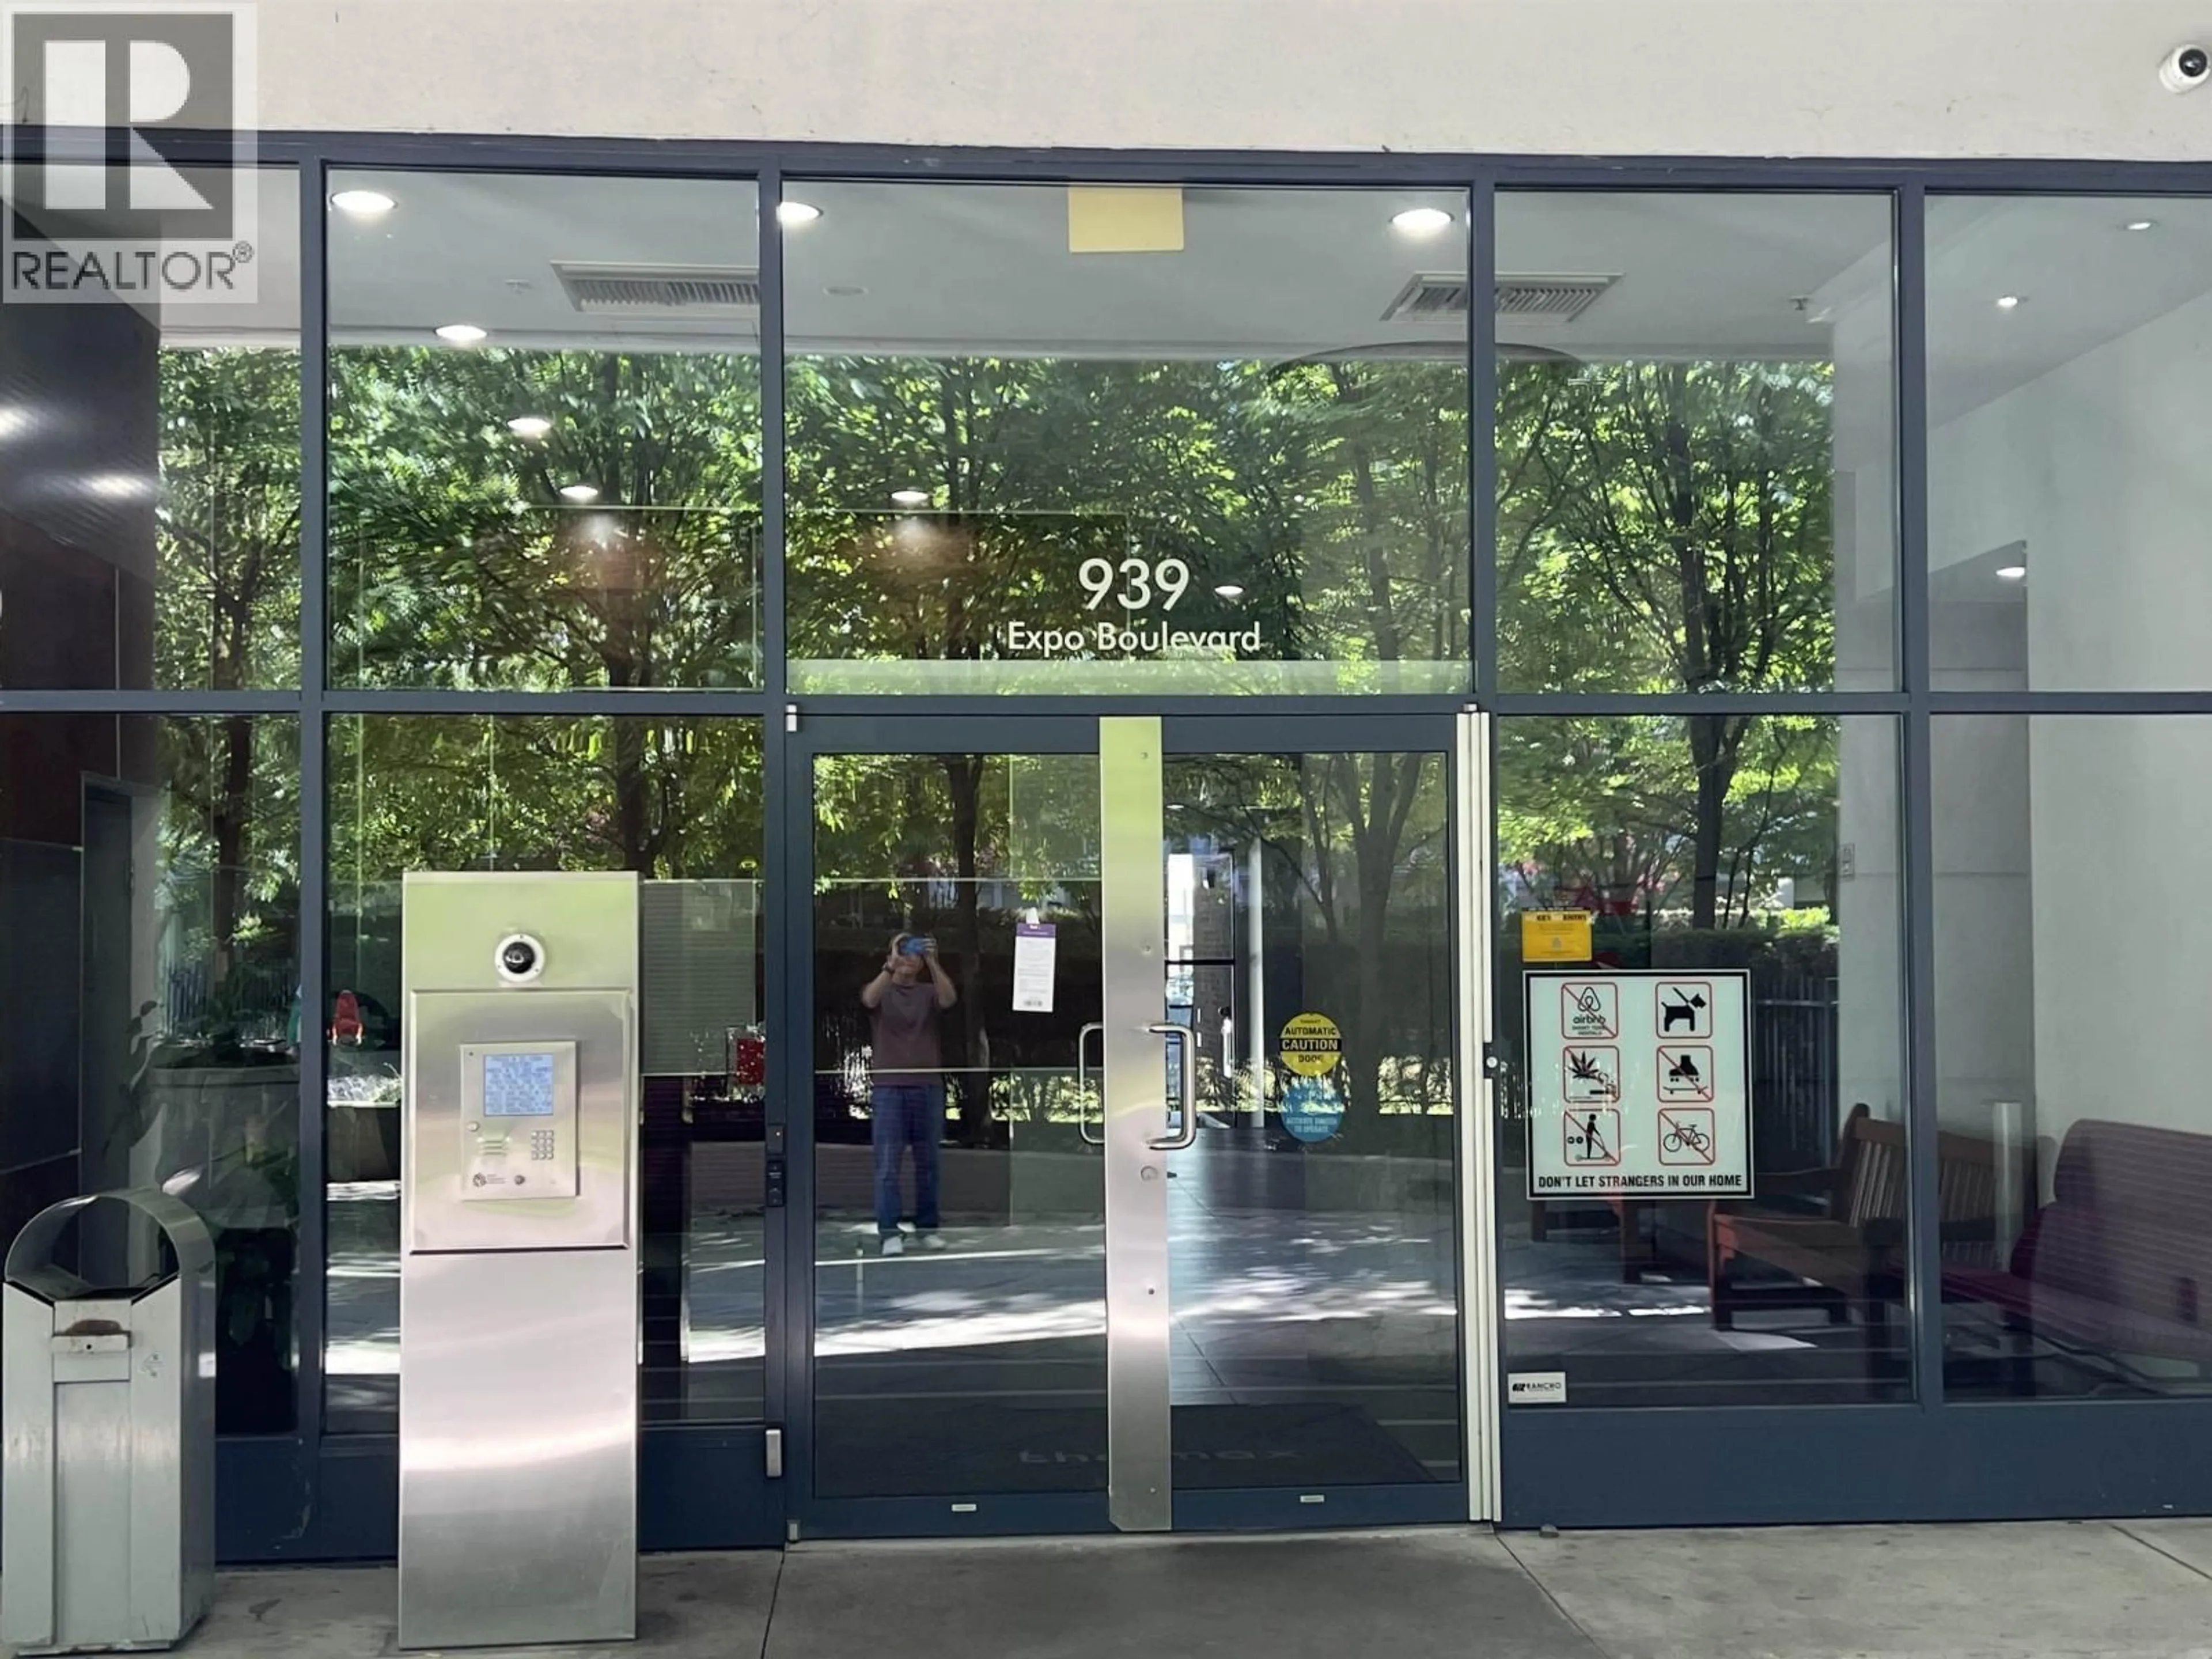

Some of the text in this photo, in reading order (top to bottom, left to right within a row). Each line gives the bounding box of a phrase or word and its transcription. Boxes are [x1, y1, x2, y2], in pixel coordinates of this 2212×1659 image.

[1078, 558, 1190, 611] 939
[1008, 621, 1260, 657] Expo Boulevard
[1285, 1027, 1336, 1035] AUTOMATIC
[1282, 1039, 1338, 1050] CAUTION
[1539, 1175, 1741, 1187] DON'T LET STRANGERS IN OUR HOME
